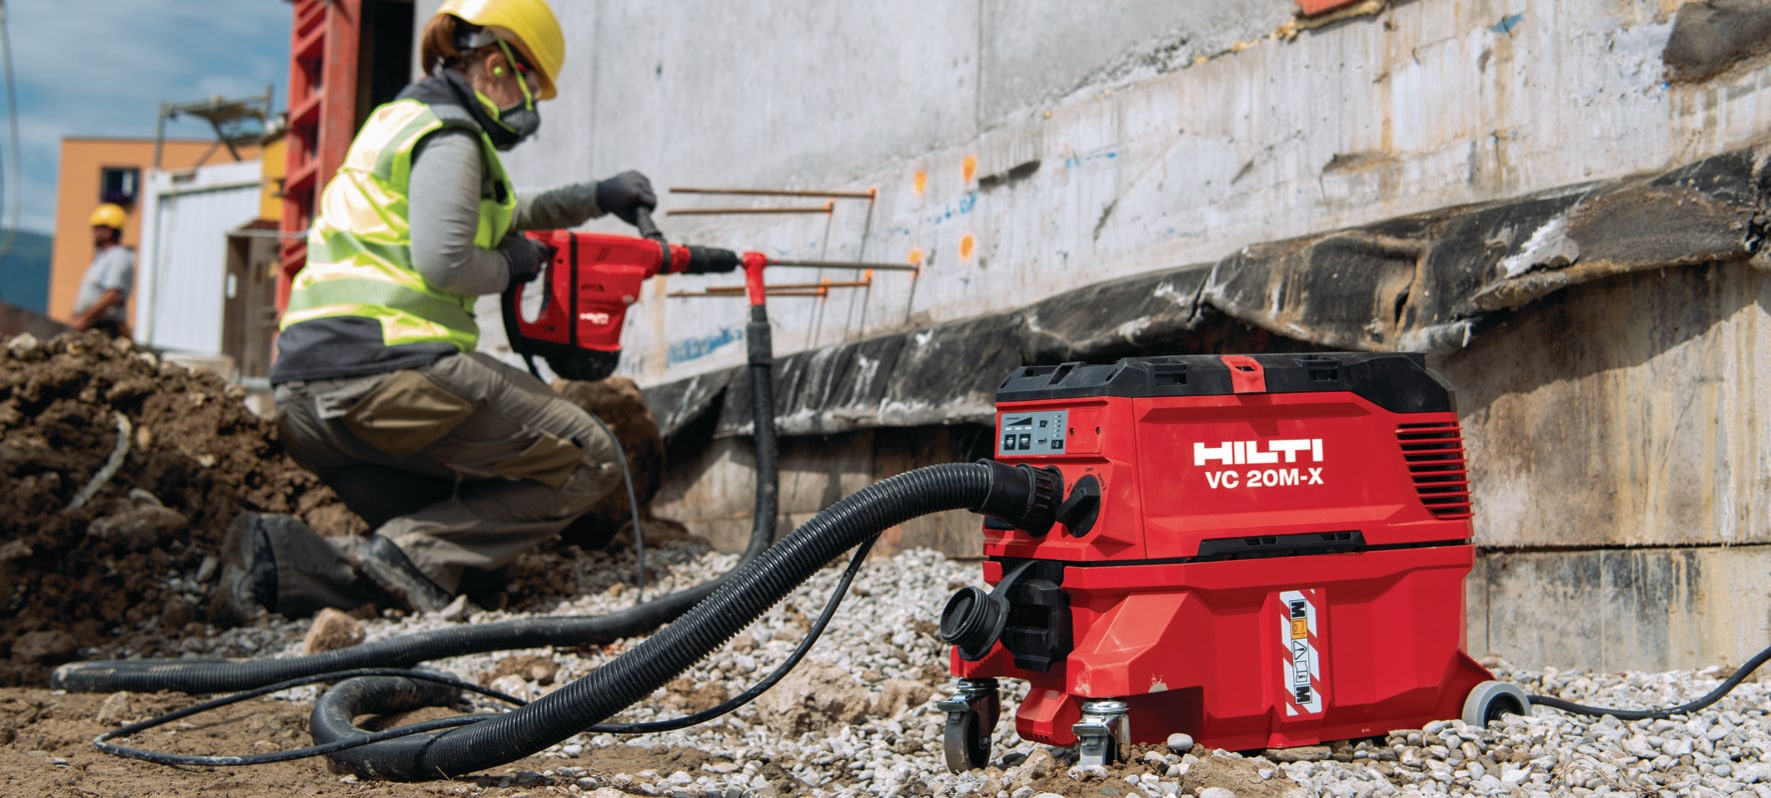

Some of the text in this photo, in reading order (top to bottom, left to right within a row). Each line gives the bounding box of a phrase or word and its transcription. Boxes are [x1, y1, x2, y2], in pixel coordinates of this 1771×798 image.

[1193, 438, 1324, 466] HILTI
[1205, 467, 1324, 489] VC 20M-X
[1290, 601, 1306, 618] M
[1295, 685, 1311, 703] M
